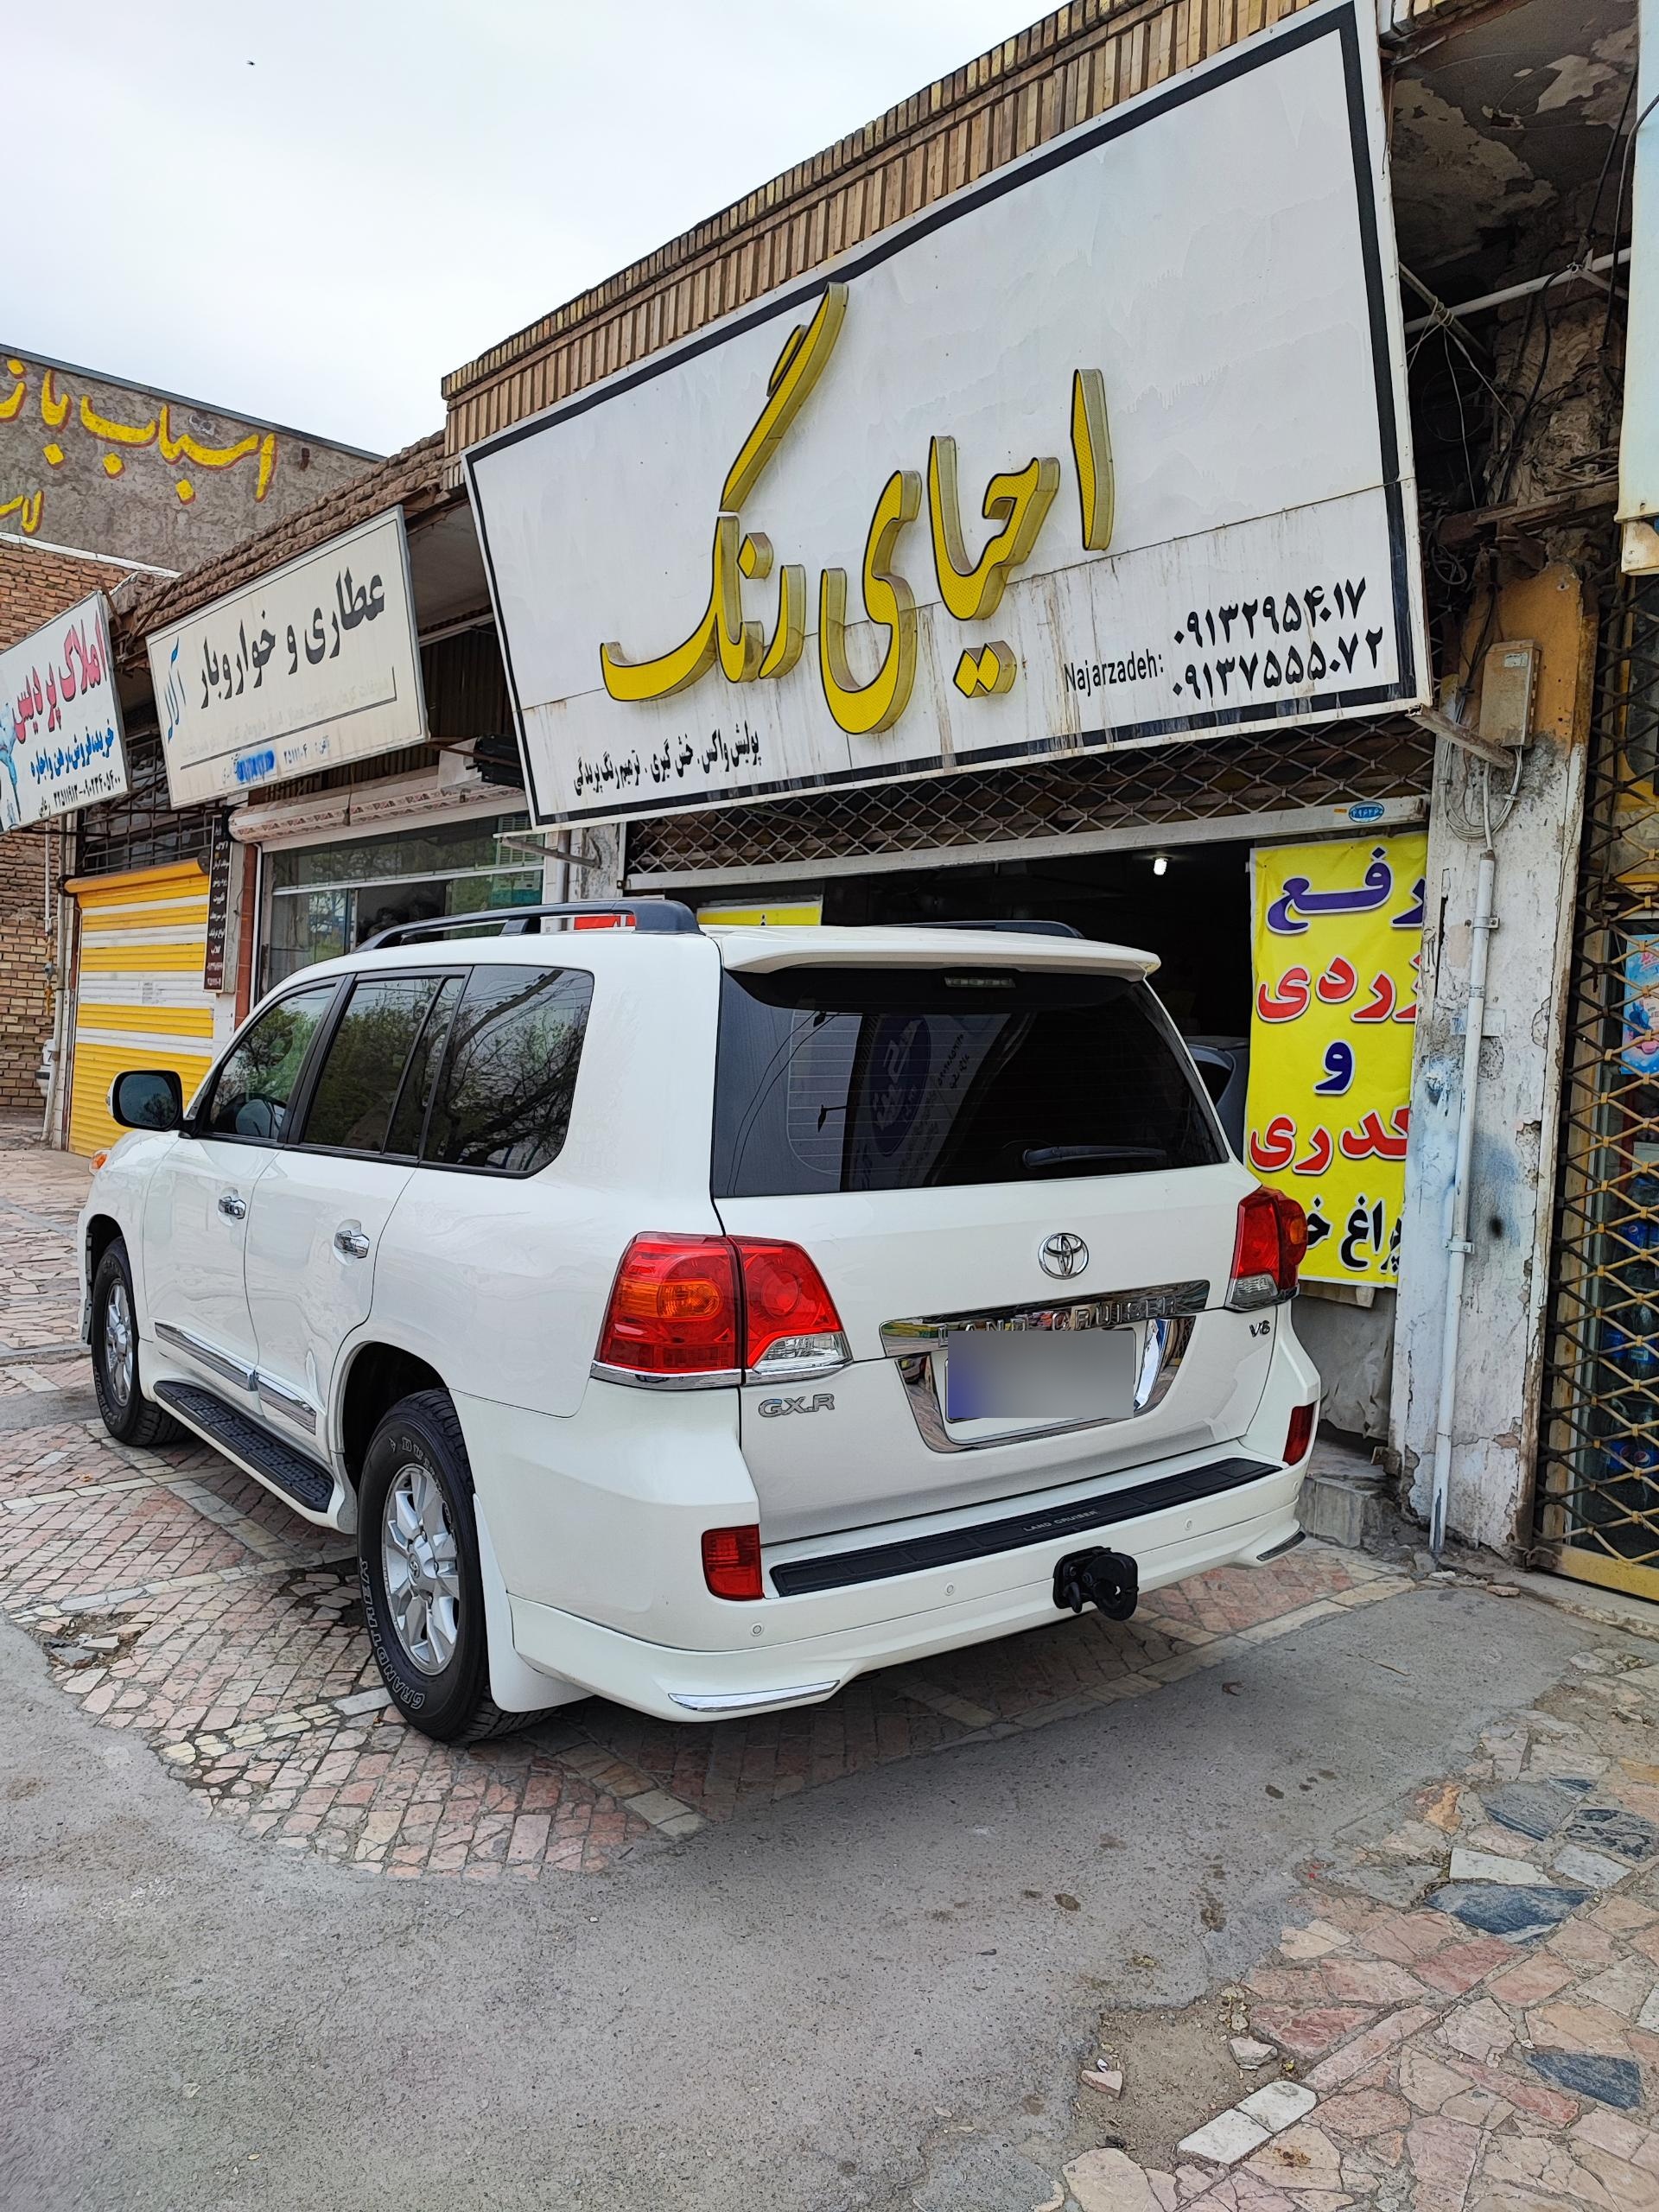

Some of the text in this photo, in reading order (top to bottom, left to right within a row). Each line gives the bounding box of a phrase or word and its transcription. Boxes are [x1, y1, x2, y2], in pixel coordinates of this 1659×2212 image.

[79, 394, 277, 505] اسباب
[600, 282, 1115, 734] احیای رنگ
[305, 566, 385, 664] عطاری
[1173, 576, 1368, 649] ۰۹۱۳۲۹۵۴۰۱۷
[59, 608, 107, 702] املاک
[201, 610, 276, 709] خواروبار
[286, 624, 298, 675] و
[1064, 648, 1165, 696] Najarzadeh:
[1173, 626, 1384, 700] ۰۹۱۳۷۵۵۵۰۷۲
[650, 738, 671, 783] گیری
[675, 733, 694, 778] خش
[702, 728, 730, 774] واکس
[731, 720, 762, 767] پولیش
[1315, 1040, 1354, 1092] و
[1051, 1296, 1178, 1332] CRUISER
[1022, 1521, 1052, 1532] LAND
